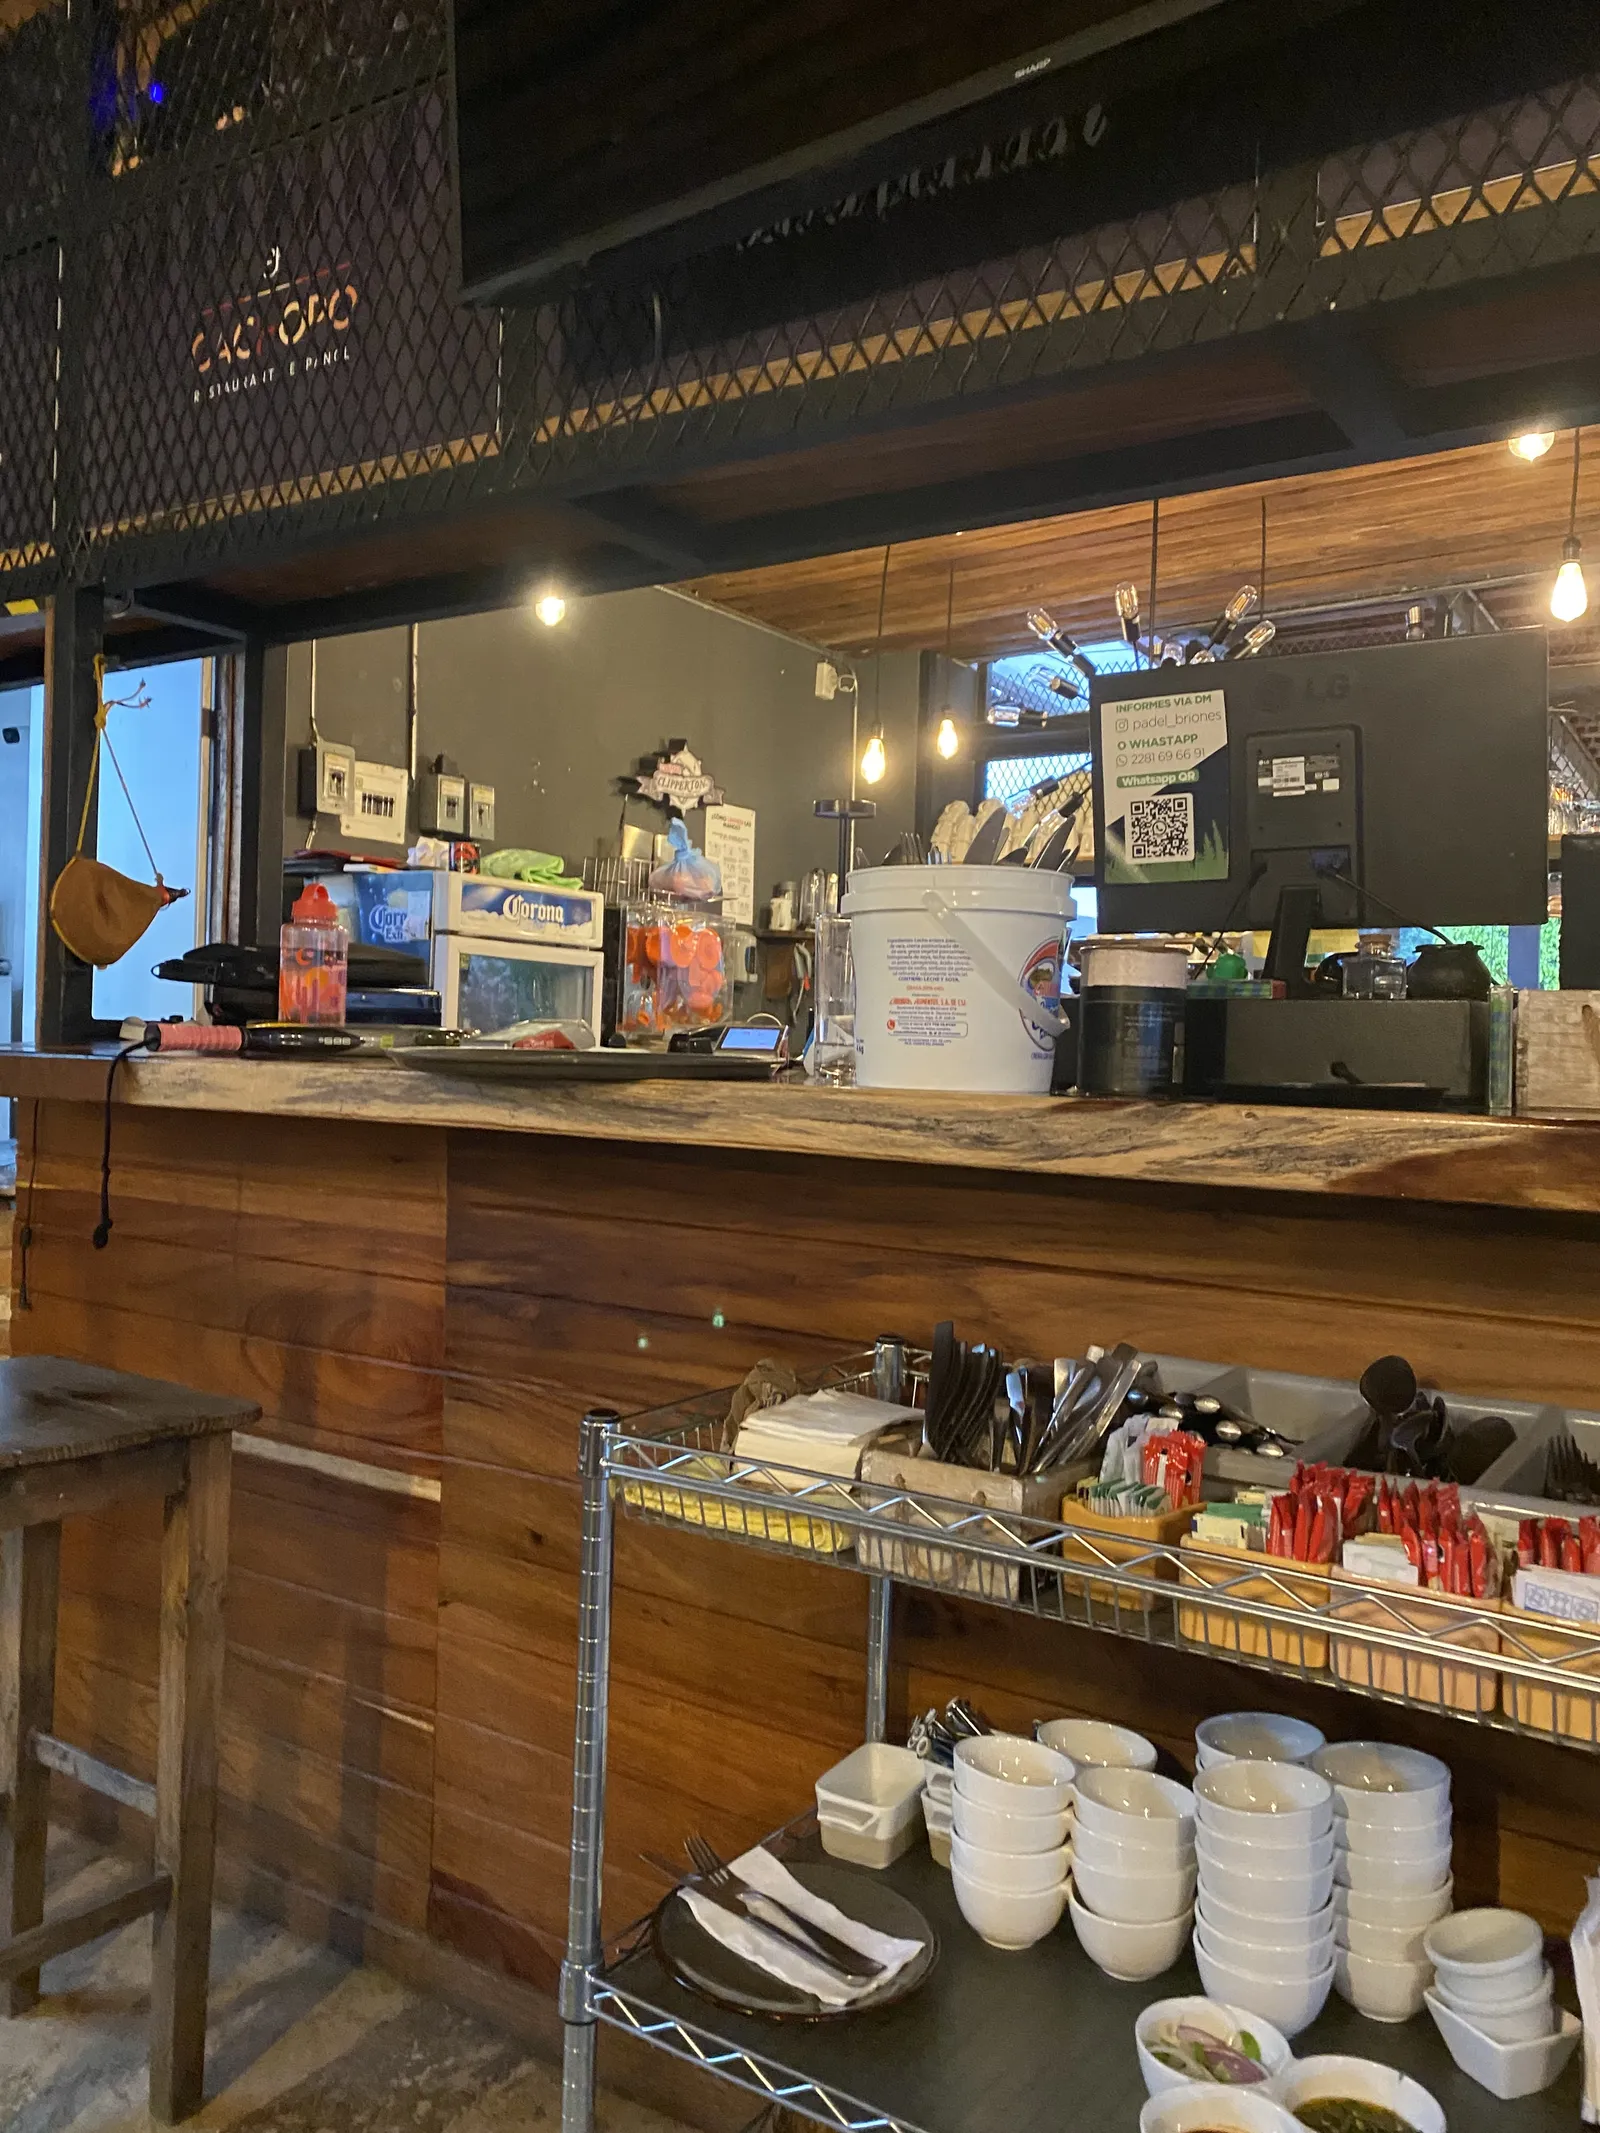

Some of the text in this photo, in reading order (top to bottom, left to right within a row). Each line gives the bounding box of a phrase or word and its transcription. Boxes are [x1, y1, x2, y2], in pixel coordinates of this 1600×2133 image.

[1116, 694, 1212, 713] INFORMES VIA DM
[1133, 711, 1222, 732] padel_briones
[1117, 734, 1198, 750] O WHASTAPP
[1131, 748, 1205, 765] 2281 69 66 91
[657, 777, 706, 791] CLIPPERTON
[1122, 770, 1196, 787] Whatsapp QR
[502, 894, 564, 925] Corona
